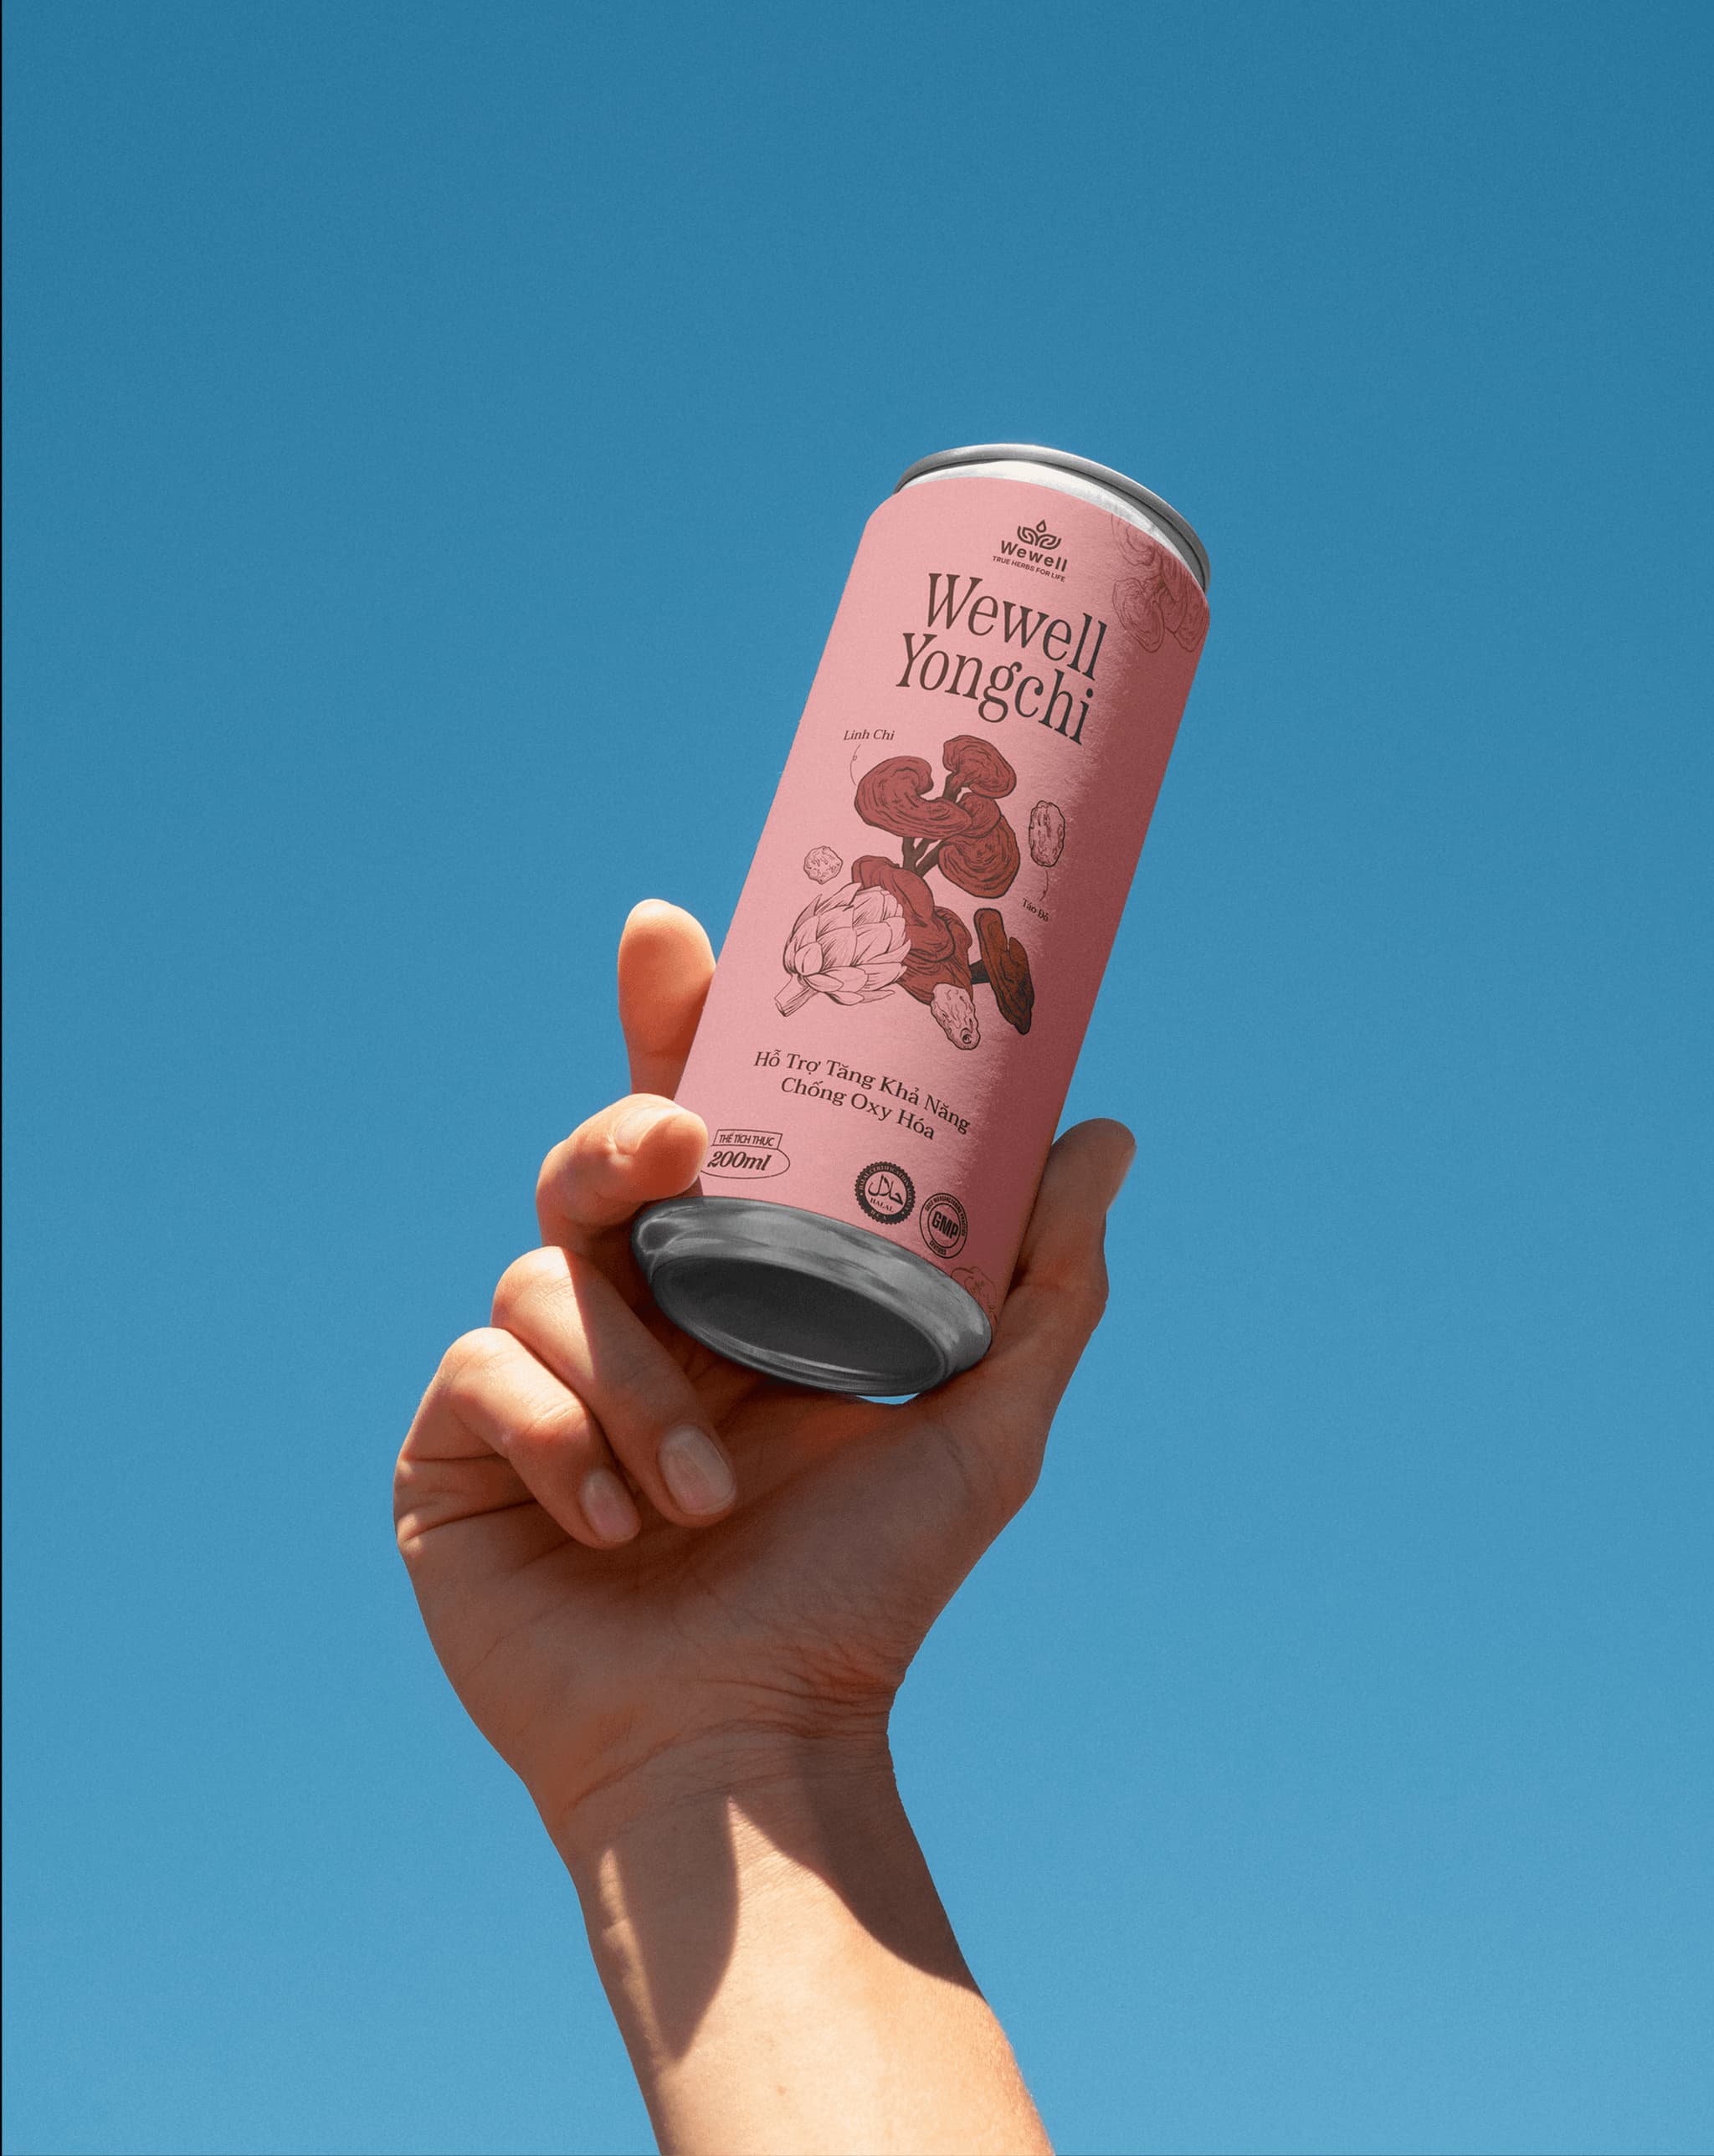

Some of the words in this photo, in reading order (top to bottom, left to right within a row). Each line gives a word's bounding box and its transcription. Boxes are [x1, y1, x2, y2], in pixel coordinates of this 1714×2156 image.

[993, 555, 1012, 566] TRUE
[1011, 561, 1035, 572] HERBS
[1035, 567, 1050, 577] FOR
[1051, 572, 1066, 583] LIFE
[1001, 540, 1068, 572] Wewell
[927, 572, 1107, 681] Wewell
[895, 633, 1094, 745] Yongchi
[844, 729, 870, 741] Linh
[873, 729, 895, 741] Chi
[753, 1049, 783, 1068] Hỗ
[787, 1053, 822, 1076] Trợ
[826, 1060, 877, 1090] Tăng
[879, 1075, 921, 1106] Khả
[923, 1094, 971, 1135] Năng
[781, 1076, 848, 1106] Chống
[850, 1092, 894, 1122] Oxy
[897, 1108, 936, 1140] Hóa
[706, 1151, 772, 1171] 200ml
[870, 1198, 894, 1213] HALAL
[931, 1210, 959, 1240] GMP
